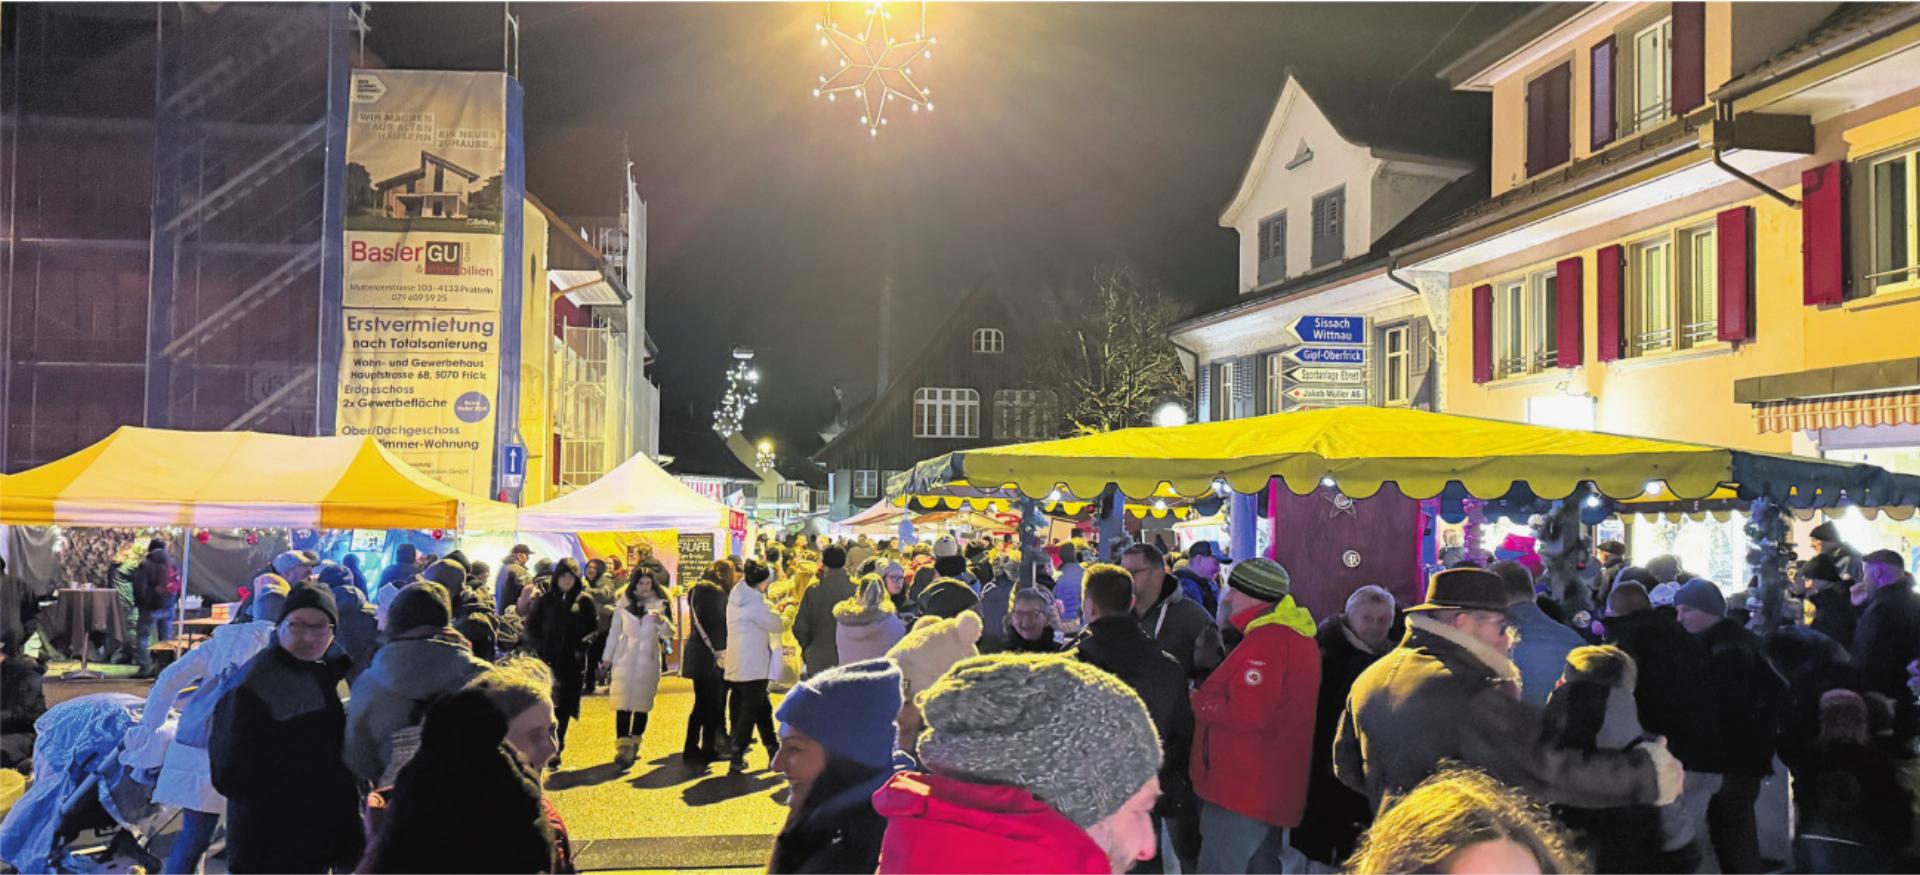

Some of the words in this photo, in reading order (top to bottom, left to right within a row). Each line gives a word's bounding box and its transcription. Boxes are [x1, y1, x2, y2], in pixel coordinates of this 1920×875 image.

[359, 113, 381, 121] WIR
[385, 113, 432, 122] MACHEN
[351, 240, 424, 262] Basler
[427, 244, 458, 263] GU
[347, 316, 494, 337] Erstvermietung
[1314, 318, 1350, 328] Sissach
[1313, 330, 1352, 340] Wittnau
[353, 338, 386, 348] nach
[390, 338, 488, 352] Totalsanierung
[1303, 350, 1361, 361] Gipf-Oberfrick
[353, 359, 386, 367] Wohn-
[389, 359, 408, 367] und
[411, 359, 485, 368] Gewerbehaus
[351, 371, 414, 381] Hauptstrasse
[435, 371, 459, 379] 5070
[462, 371, 486, 380] Frick
[344, 385, 415, 395] Erdgeschoss
[343, 400, 355, 408] 2x
[358, 399, 447, 408] Gewerbefläche
